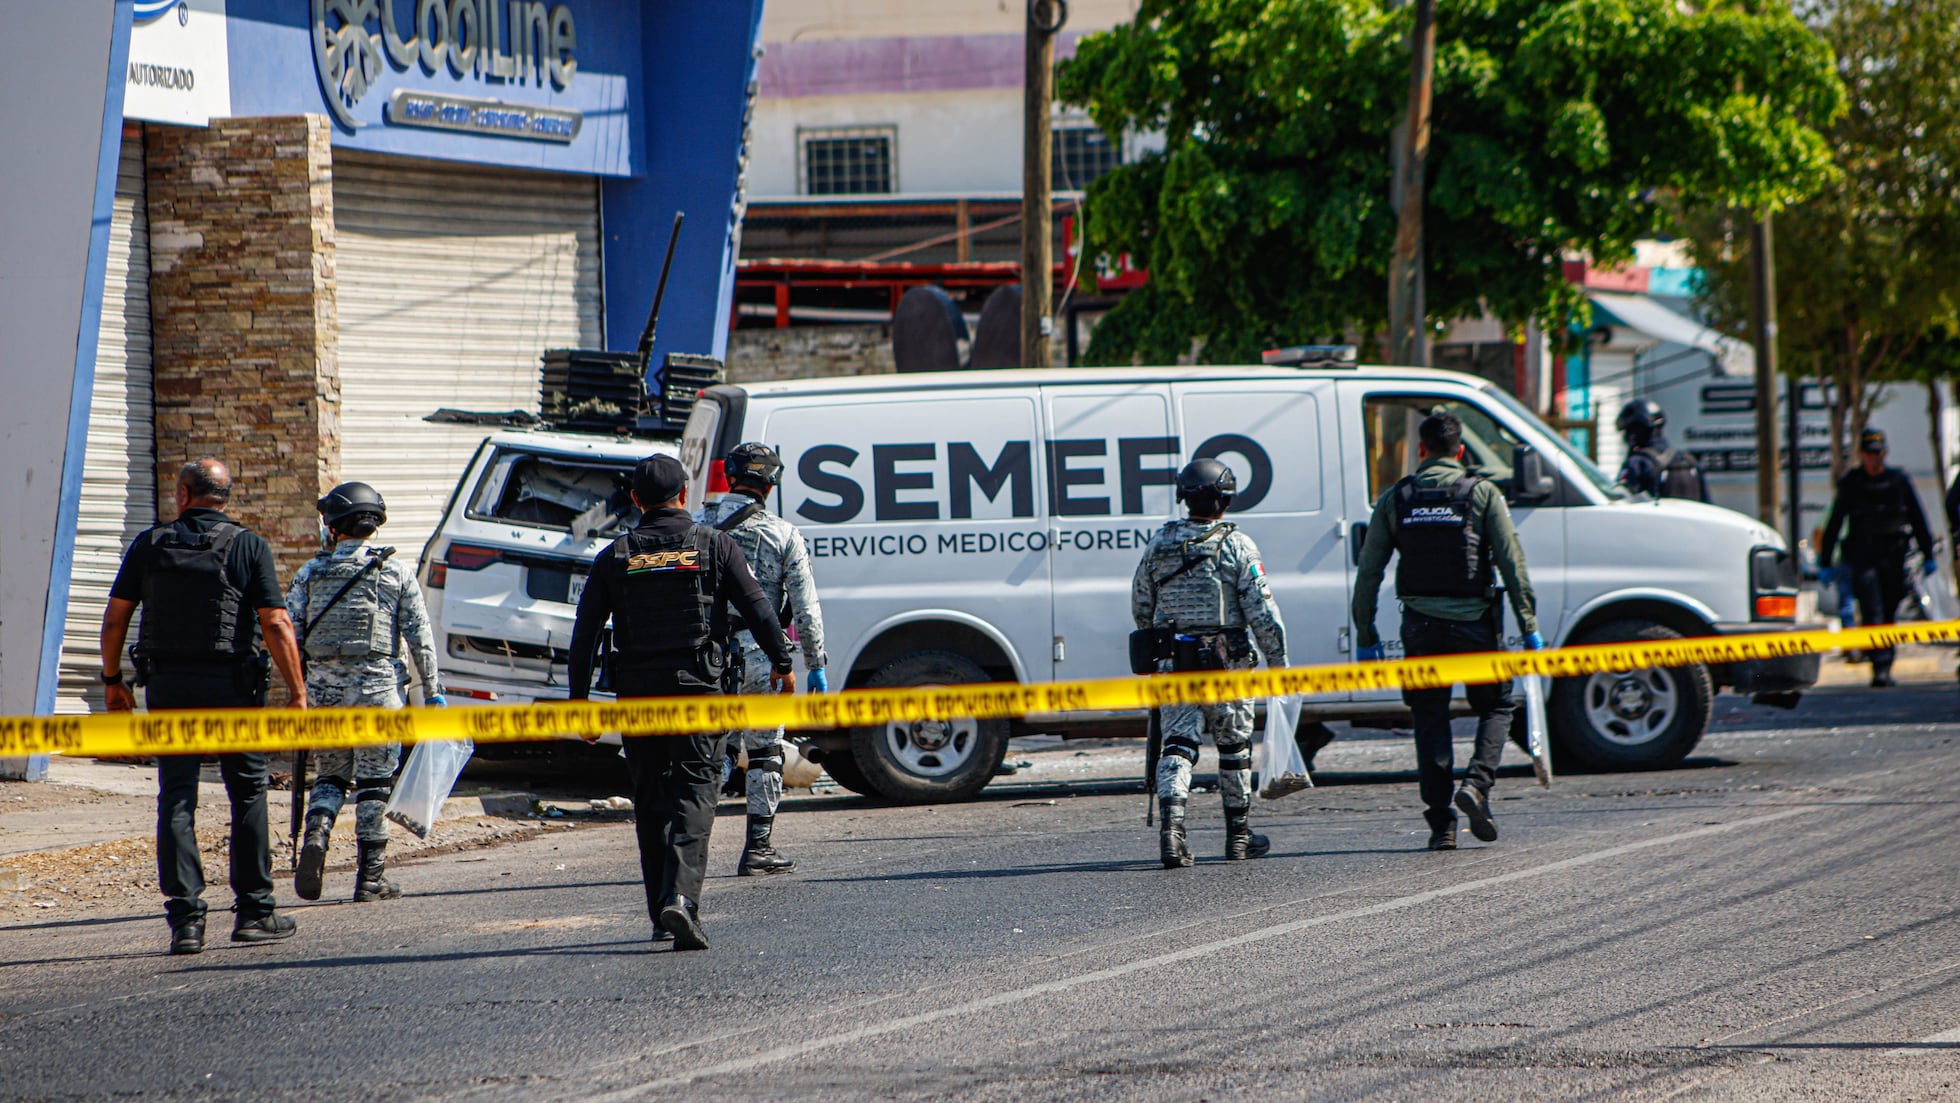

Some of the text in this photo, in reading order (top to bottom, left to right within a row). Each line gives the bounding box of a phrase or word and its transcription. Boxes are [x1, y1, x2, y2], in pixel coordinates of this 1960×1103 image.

[381, 0, 577, 88] CoolLine
[128, 62, 194, 91] AUTORIZADO
[796, 433, 1273, 523] SEMEFO
[1411, 507, 1453, 517] POLICIA
[938, 532, 1047, 553] MEDICO
[1058, 529, 1151, 550] FOREN
[627, 551, 699, 571] SSPC
[131, 711, 415, 746] LINEA DE POLICIA PROHIBIDO EL PASO
[600, 703, 682, 732] PROHIBIDO
[708, 701, 749, 728] PASO
[43, 717, 82, 748] PASO
